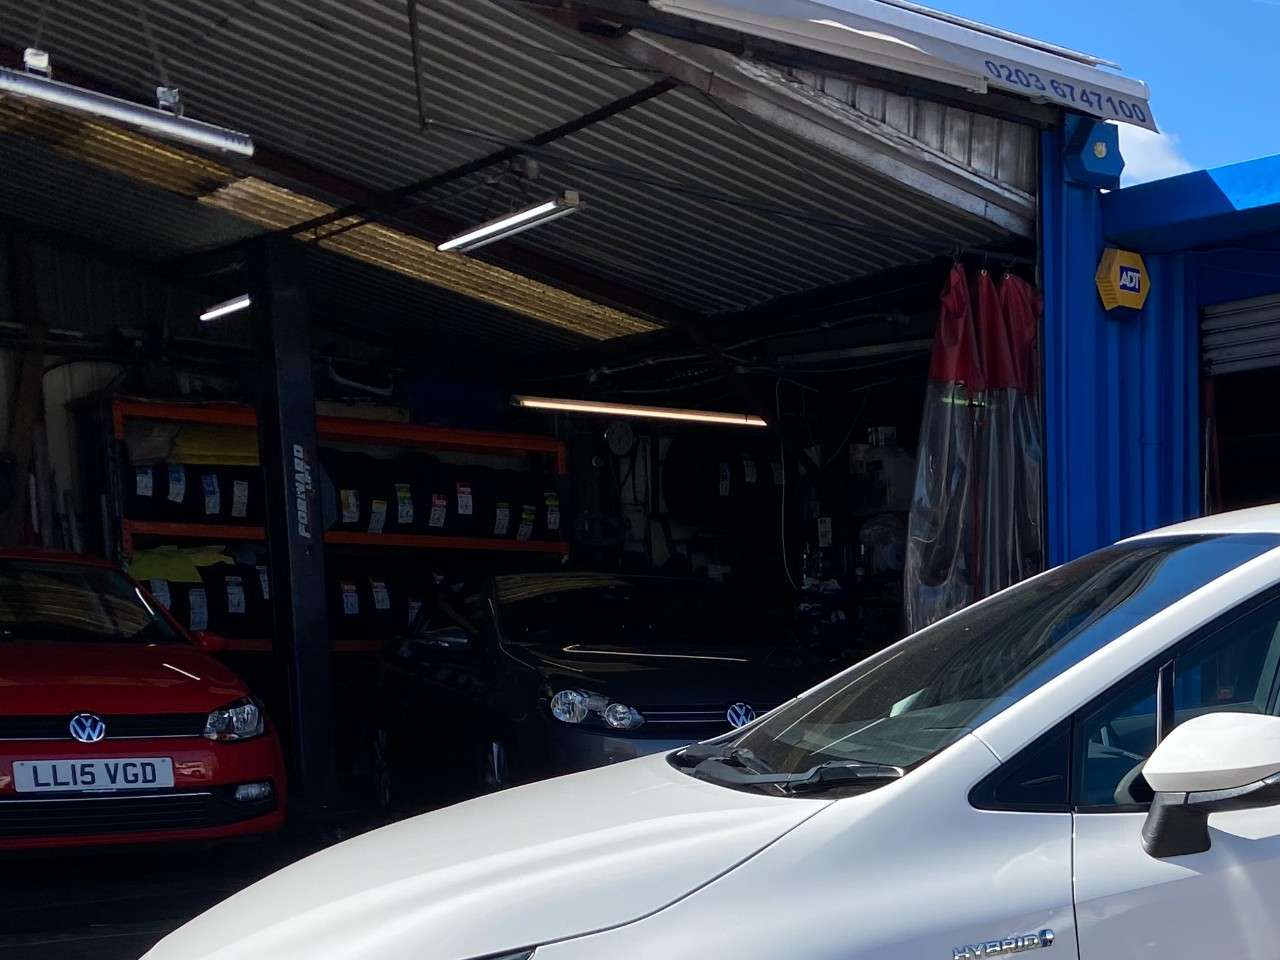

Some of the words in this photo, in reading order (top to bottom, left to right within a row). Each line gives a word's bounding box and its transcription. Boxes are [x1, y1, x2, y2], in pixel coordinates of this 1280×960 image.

[984, 60, 1046, 92] 0203
[1050, 79, 1147, 123] 6747100
[1120, 271, 1142, 289] ADT
[32, 763, 96, 787] LL15
[104, 762, 157, 785] VGD
[952, 932, 1039, 960] HYBRID
